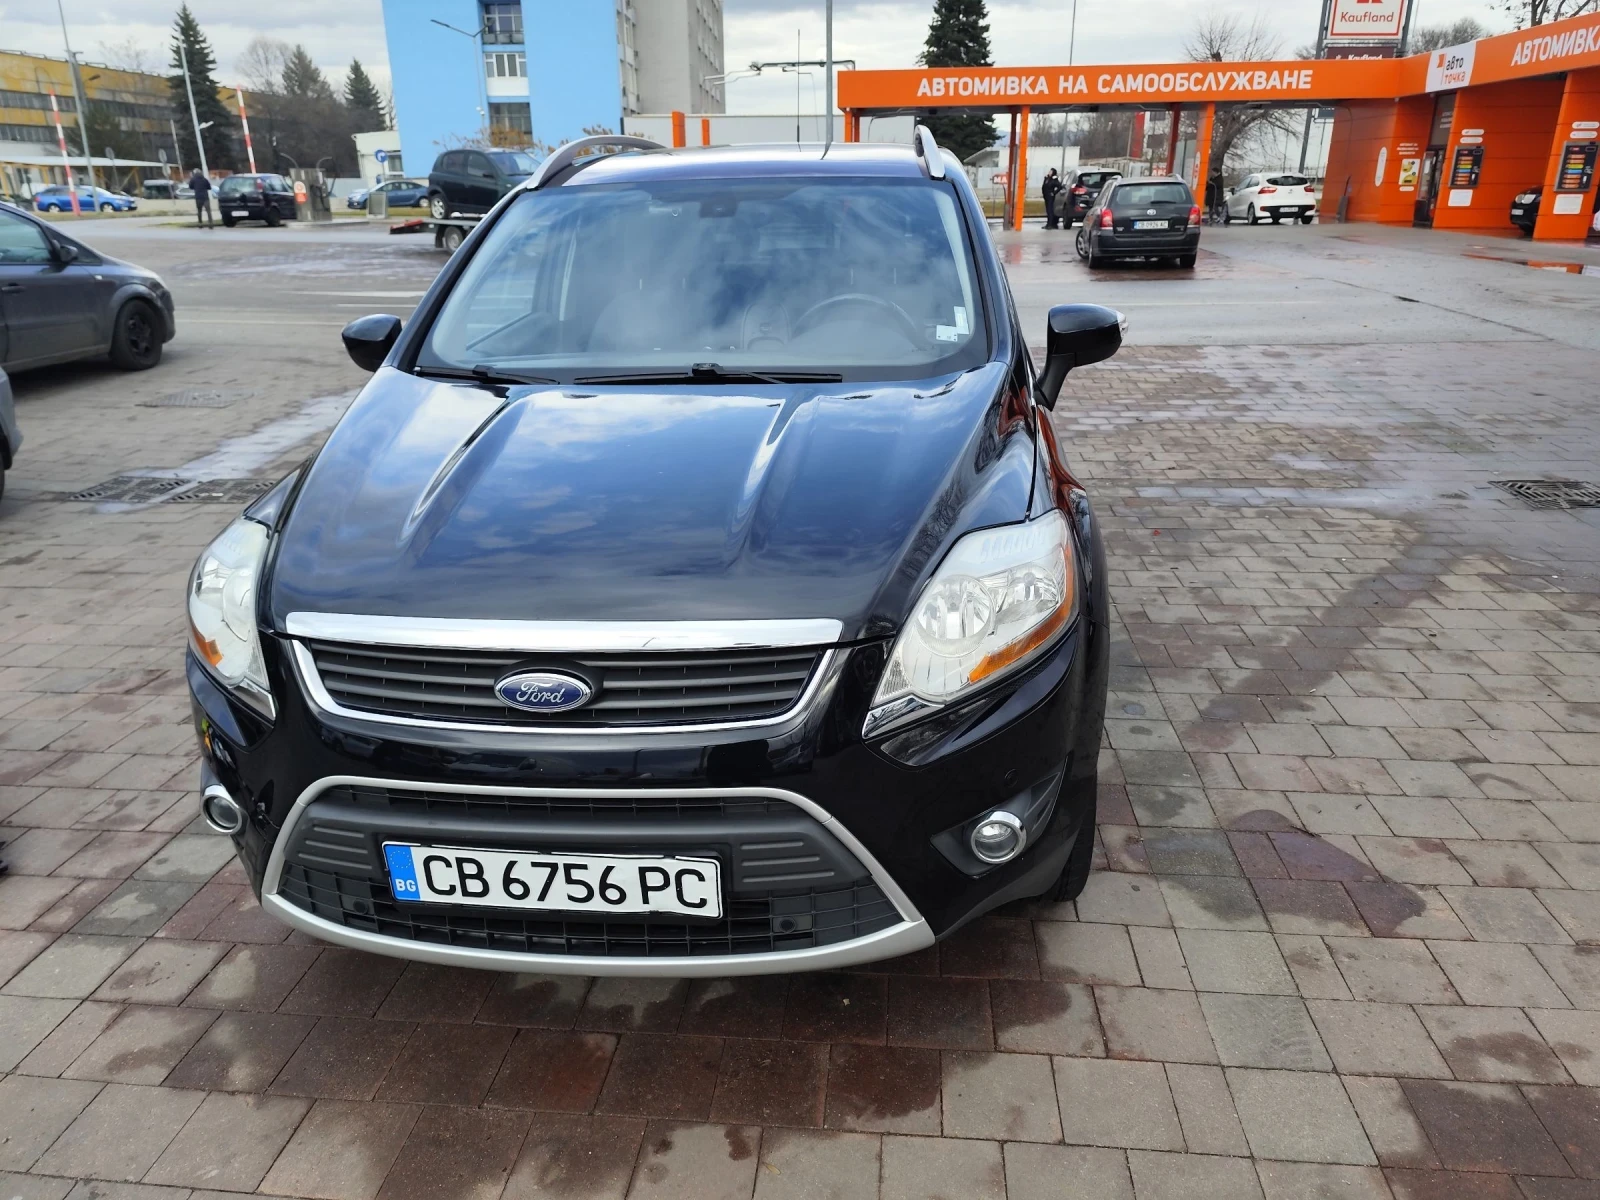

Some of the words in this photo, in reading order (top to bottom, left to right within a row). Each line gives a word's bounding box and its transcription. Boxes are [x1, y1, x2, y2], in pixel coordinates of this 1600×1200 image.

[1340, 11, 1394, 23] Kaufland
[1446, 55, 1464, 71] авто
[917, 76, 1049, 97] АВТОМИВКА
[1058, 75, 1088, 94] НА
[1097, 70, 1313, 93] САМООБСЛУЖВАНЕ
[1445, 71, 1466, 84] точка
[516, 681, 565, 703] Ford
[395, 879, 416, 892] BG
[422, 855, 490, 898] CB
[502, 860, 627, 905] 6756
[638, 866, 707, 908] PC
